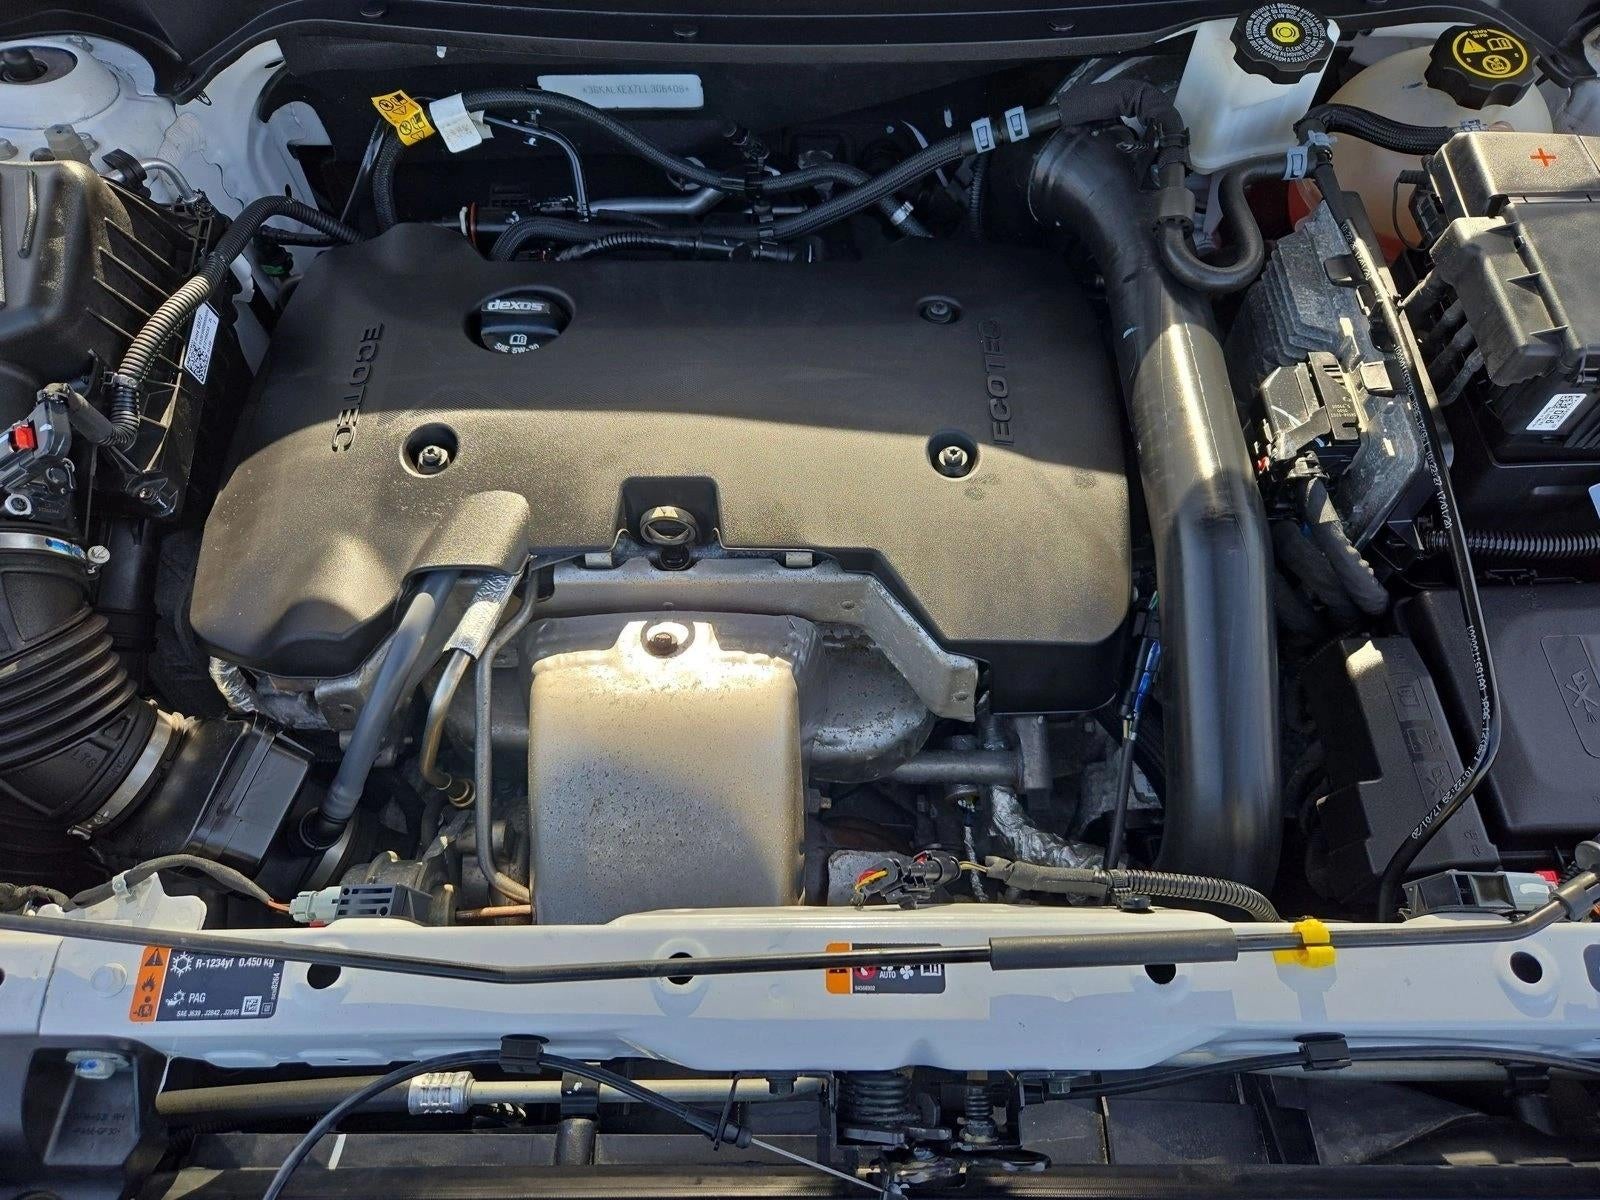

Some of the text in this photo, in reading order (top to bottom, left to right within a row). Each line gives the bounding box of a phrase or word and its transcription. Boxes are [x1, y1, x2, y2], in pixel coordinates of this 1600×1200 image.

[487, 299, 545, 311] dexos
[494, 342, 510, 353] SAE
[331, 321, 385, 453] ECOTEC
[977, 319, 1015, 446] ECOTEC
[195, 958, 234, 970] R-1234yf
[879, 971, 896, 979] AUTO
[188, 992, 206, 1003] PAG
